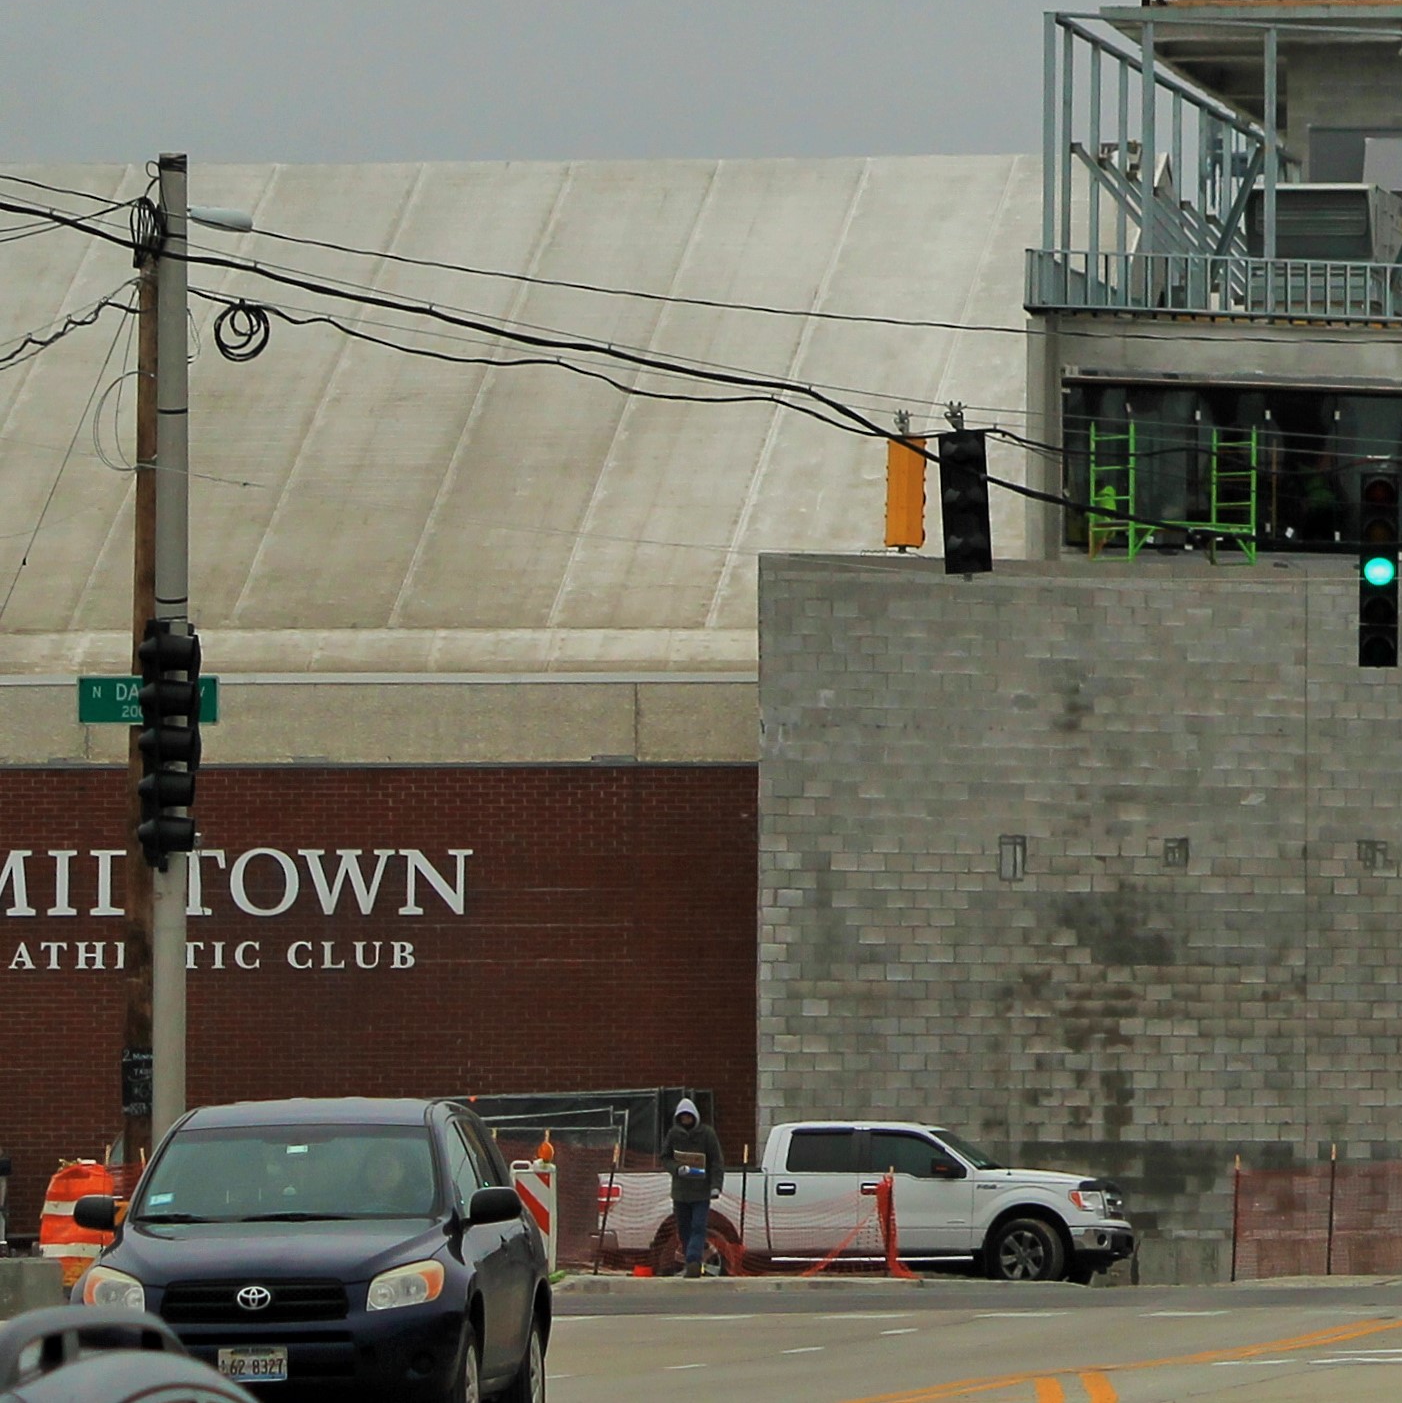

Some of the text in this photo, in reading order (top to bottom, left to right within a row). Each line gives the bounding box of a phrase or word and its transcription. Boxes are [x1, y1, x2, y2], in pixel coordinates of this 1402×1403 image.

[93, 683, 140, 701] N DA
[8, 941, 416, 969] ATHTIC CLUB
[252, 1358, 283, 1375] 8327
